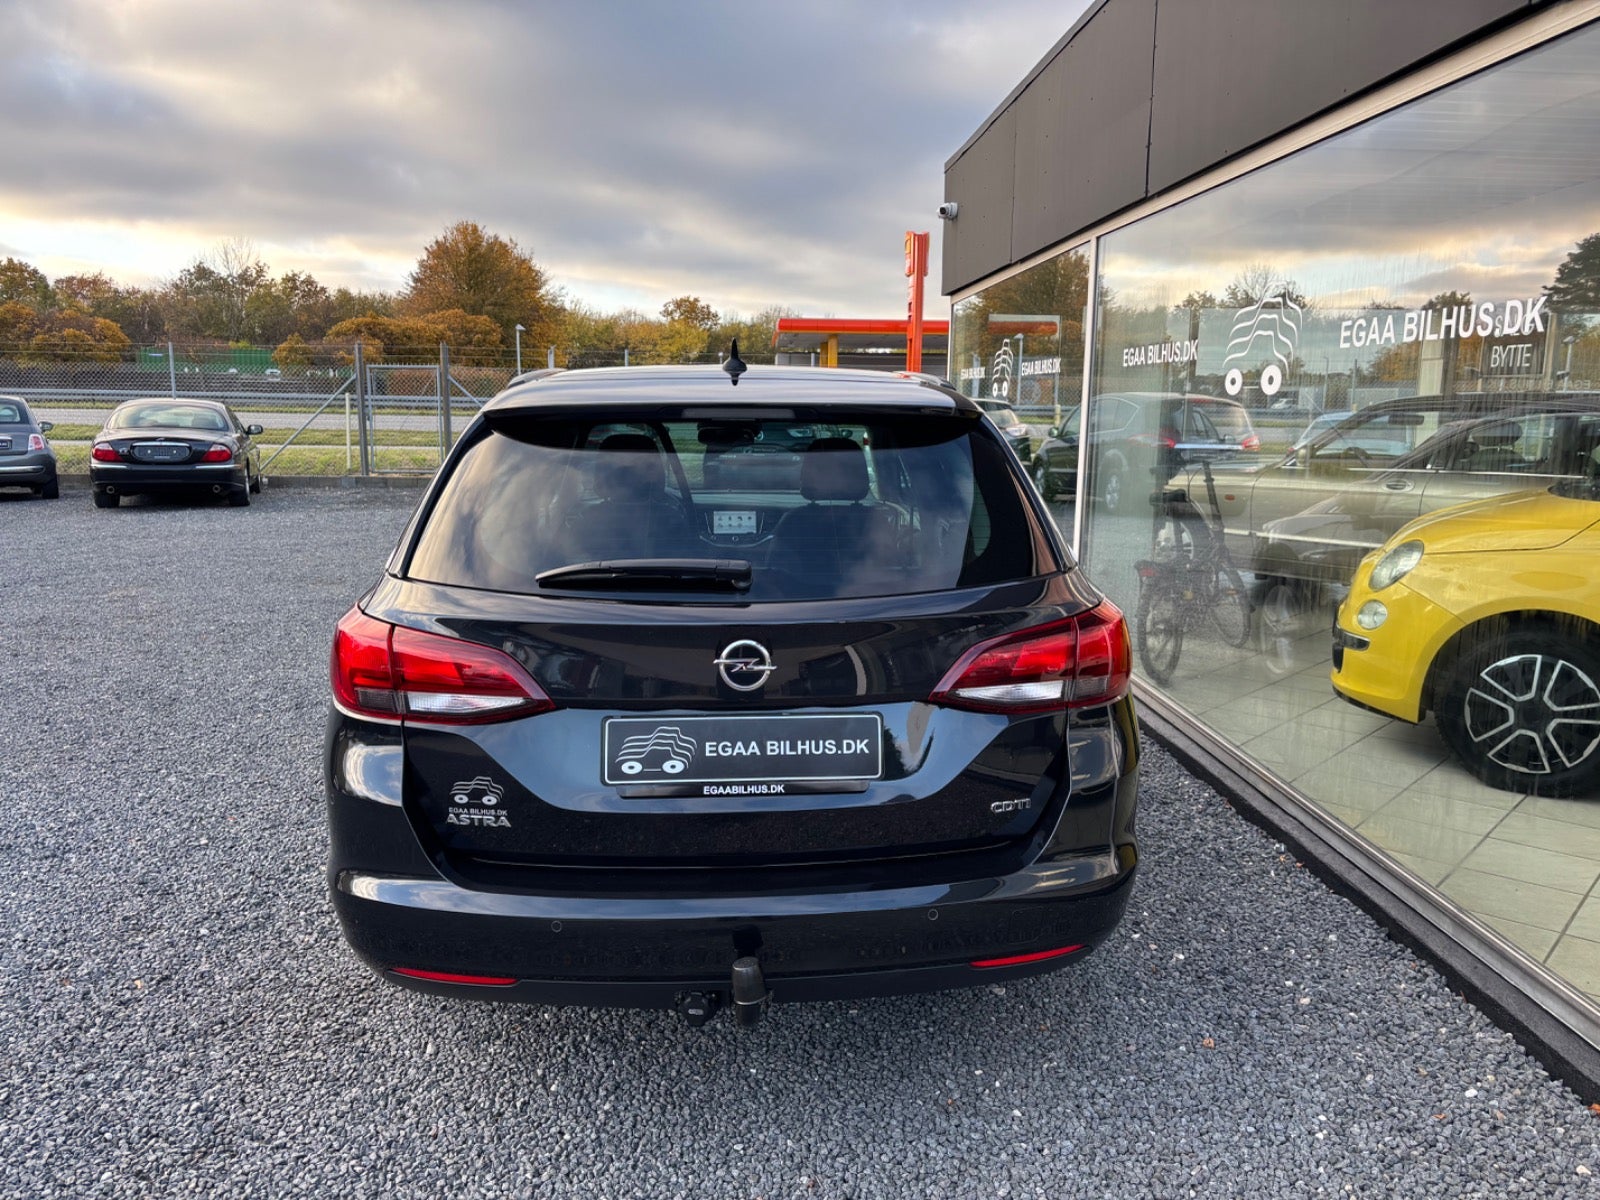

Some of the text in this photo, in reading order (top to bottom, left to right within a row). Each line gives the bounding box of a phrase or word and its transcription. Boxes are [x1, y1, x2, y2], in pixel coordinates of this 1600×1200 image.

[1339, 295, 1548, 349] EGAA BILHUS.DK
[1123, 339, 1199, 367] EGAA BILHUS.DK
[1490, 343, 1533, 368] BYTTE
[705, 739, 869, 757] EGAA BILHUS.DK
[703, 784, 785, 795] EGAABILHUS.DK
[446, 813, 512, 828] ASTRA
[469, 808, 508, 816] BILHUS.DK
